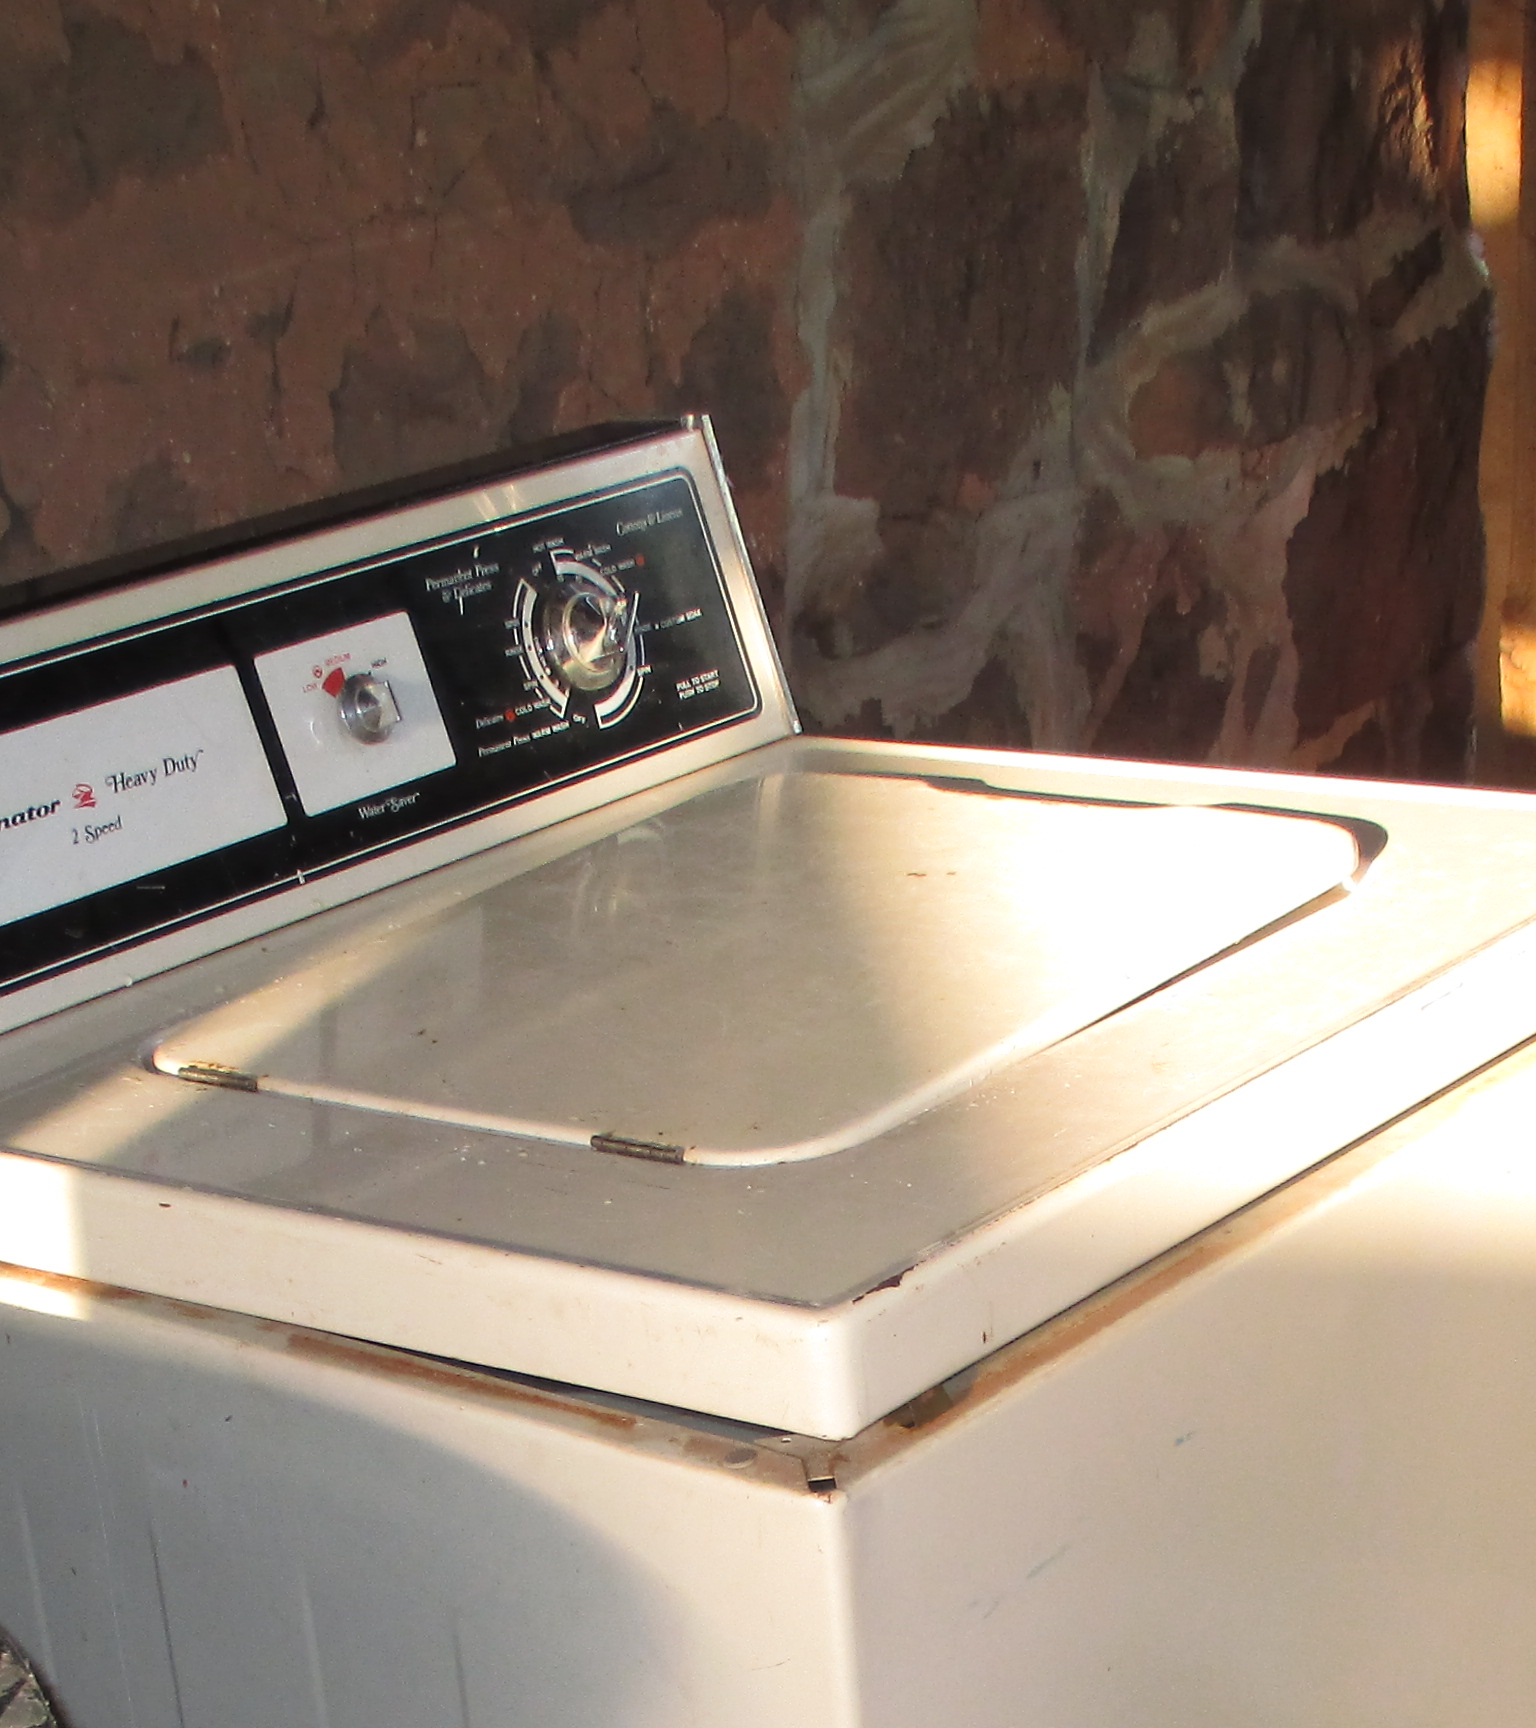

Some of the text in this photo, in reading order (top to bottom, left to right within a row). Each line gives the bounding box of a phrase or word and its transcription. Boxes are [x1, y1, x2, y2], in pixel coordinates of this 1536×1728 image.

[105, 766, 159, 794] Heavy
[163, 751, 204, 777] Duty
[358, 792, 421, 820] Water Saver
[71, 814, 124, 845] 2 Speed
